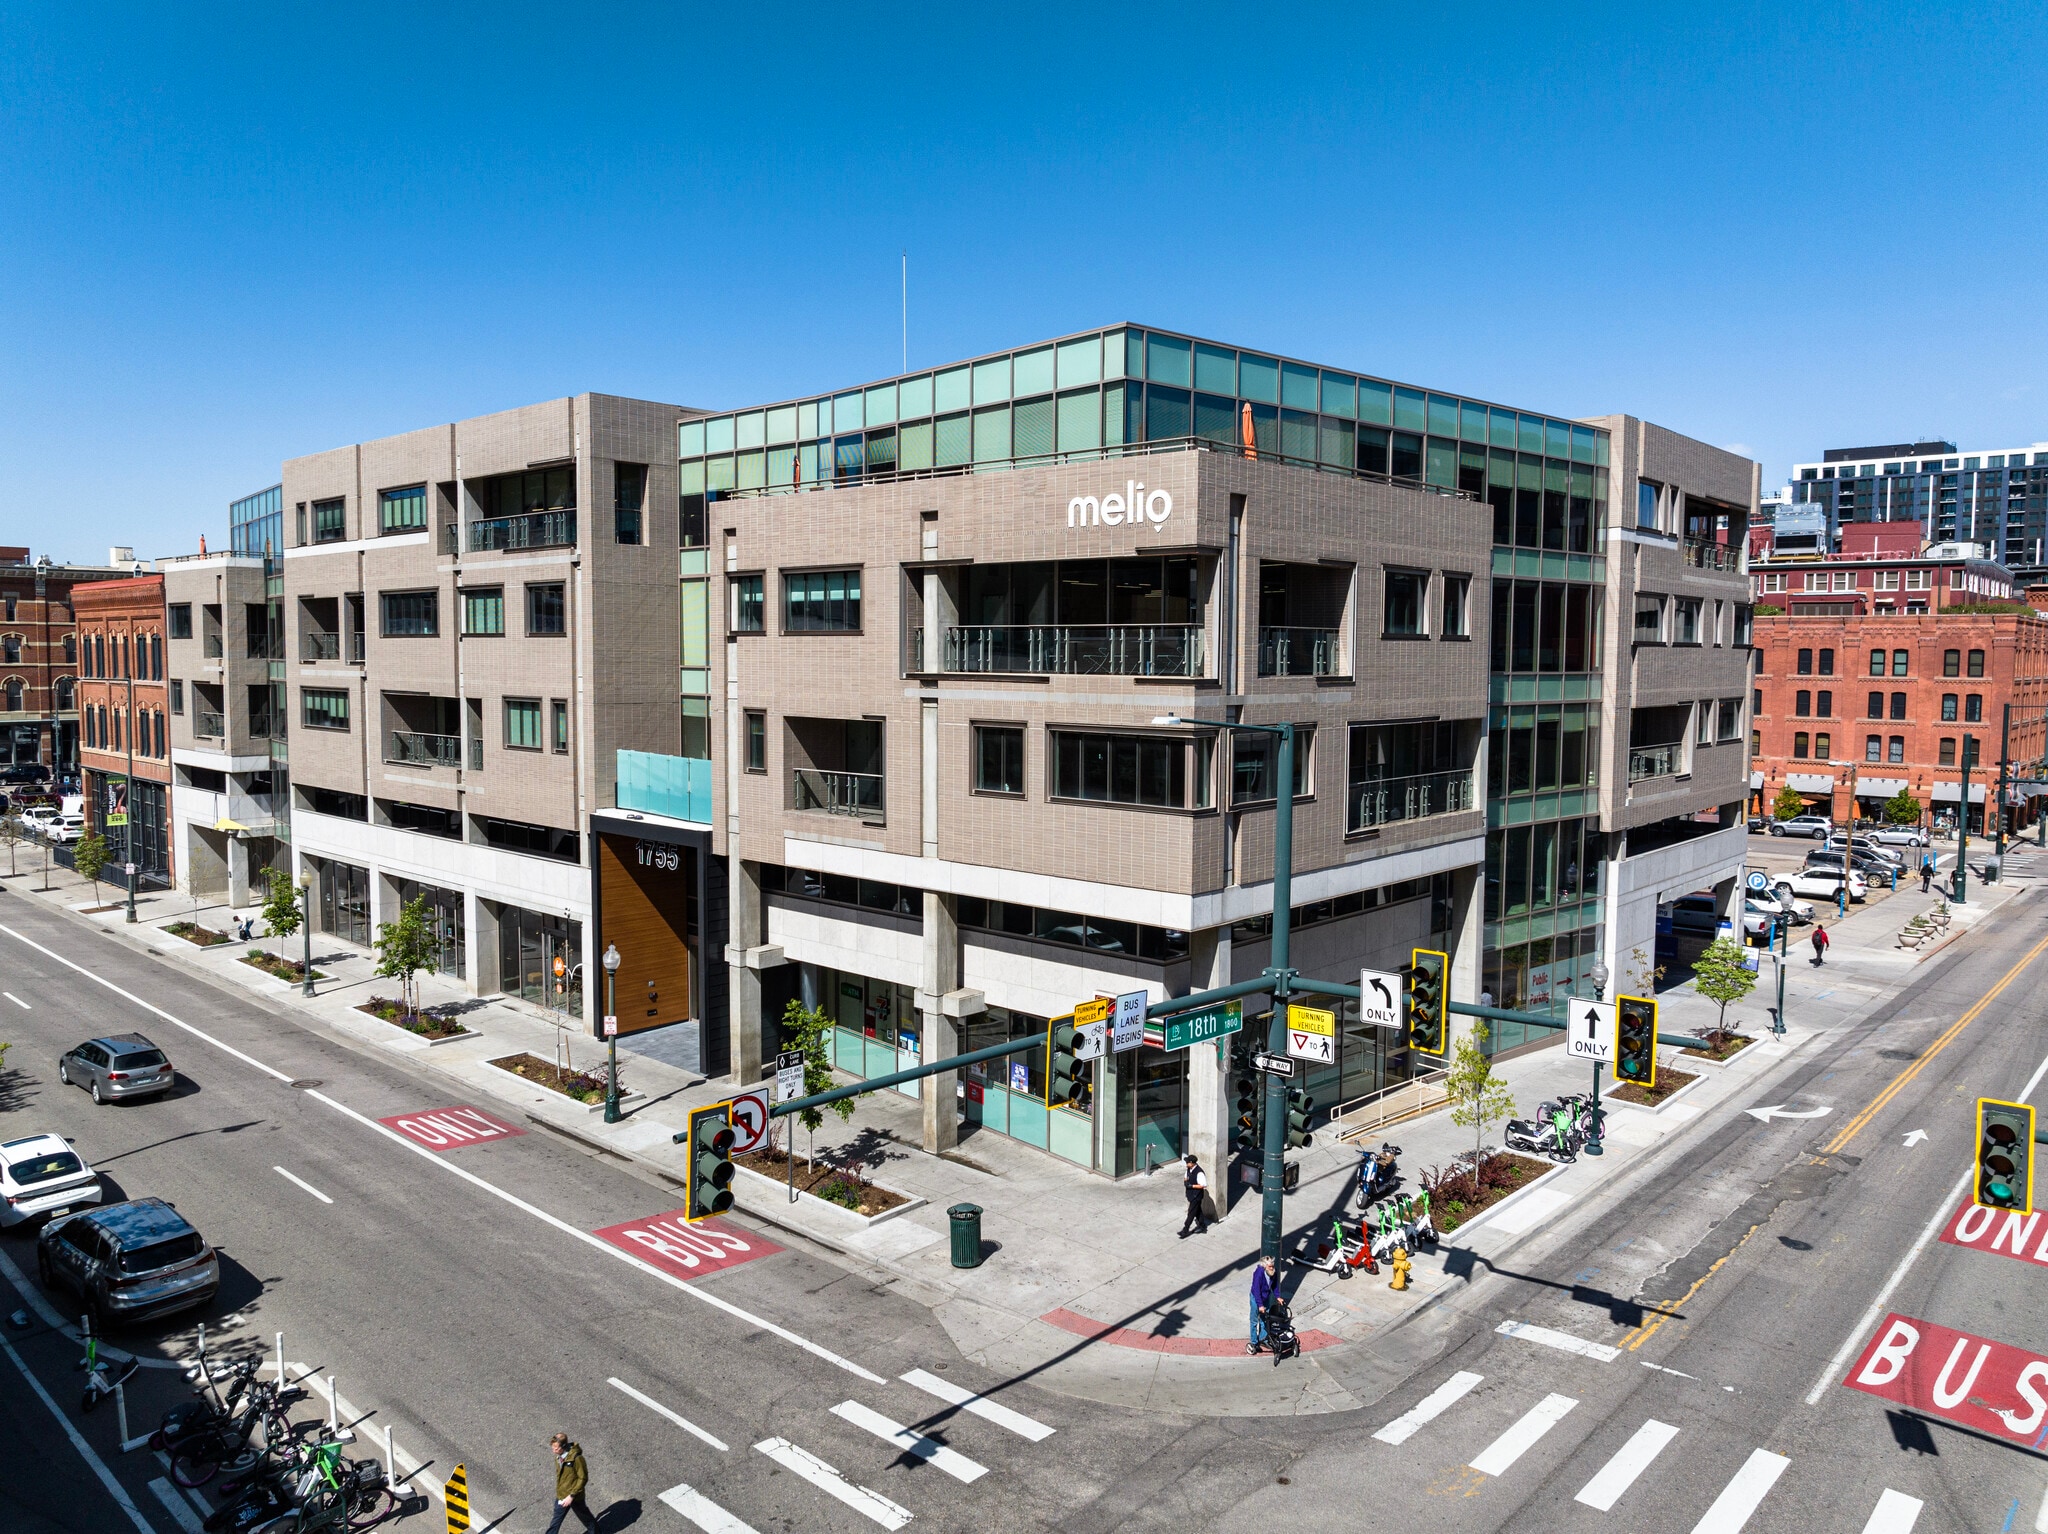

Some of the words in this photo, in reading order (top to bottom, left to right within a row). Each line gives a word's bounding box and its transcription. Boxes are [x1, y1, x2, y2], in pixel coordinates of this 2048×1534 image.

[1068, 480, 1172, 533] melio
[635, 839, 679, 871] 1755
[1532, 972, 1548, 987] Public
[1124, 999, 1139, 1011] BUS
[1530, 990, 1550, 1006] Parking
[1077, 1004, 1097, 1015] TURNING
[1297, 1011, 1325, 1022] TURNING
[1367, 1008, 1396, 1022] ONLY
[1076, 1013, 1097, 1023] VEHICLES
[1120, 1014, 1140, 1028] LANE
[1188, 1013, 1217, 1039] 18th
[1297, 1021, 1325, 1033] VEHICLES
[1085, 1038, 1092, 1046] TO
[1115, 1030, 1142, 1045] BEGINS
[1309, 1042, 1318, 1050] TO
[1575, 1040, 1608, 1056] ONLY
[1262, 1058, 1274, 1067] ONE
[1276, 1061, 1289, 1070] WAY
[397, 1108, 509, 1145] ONLY
[622, 1216, 751, 1269] BUS
[1856, 1319, 2048, 1435] BUS
